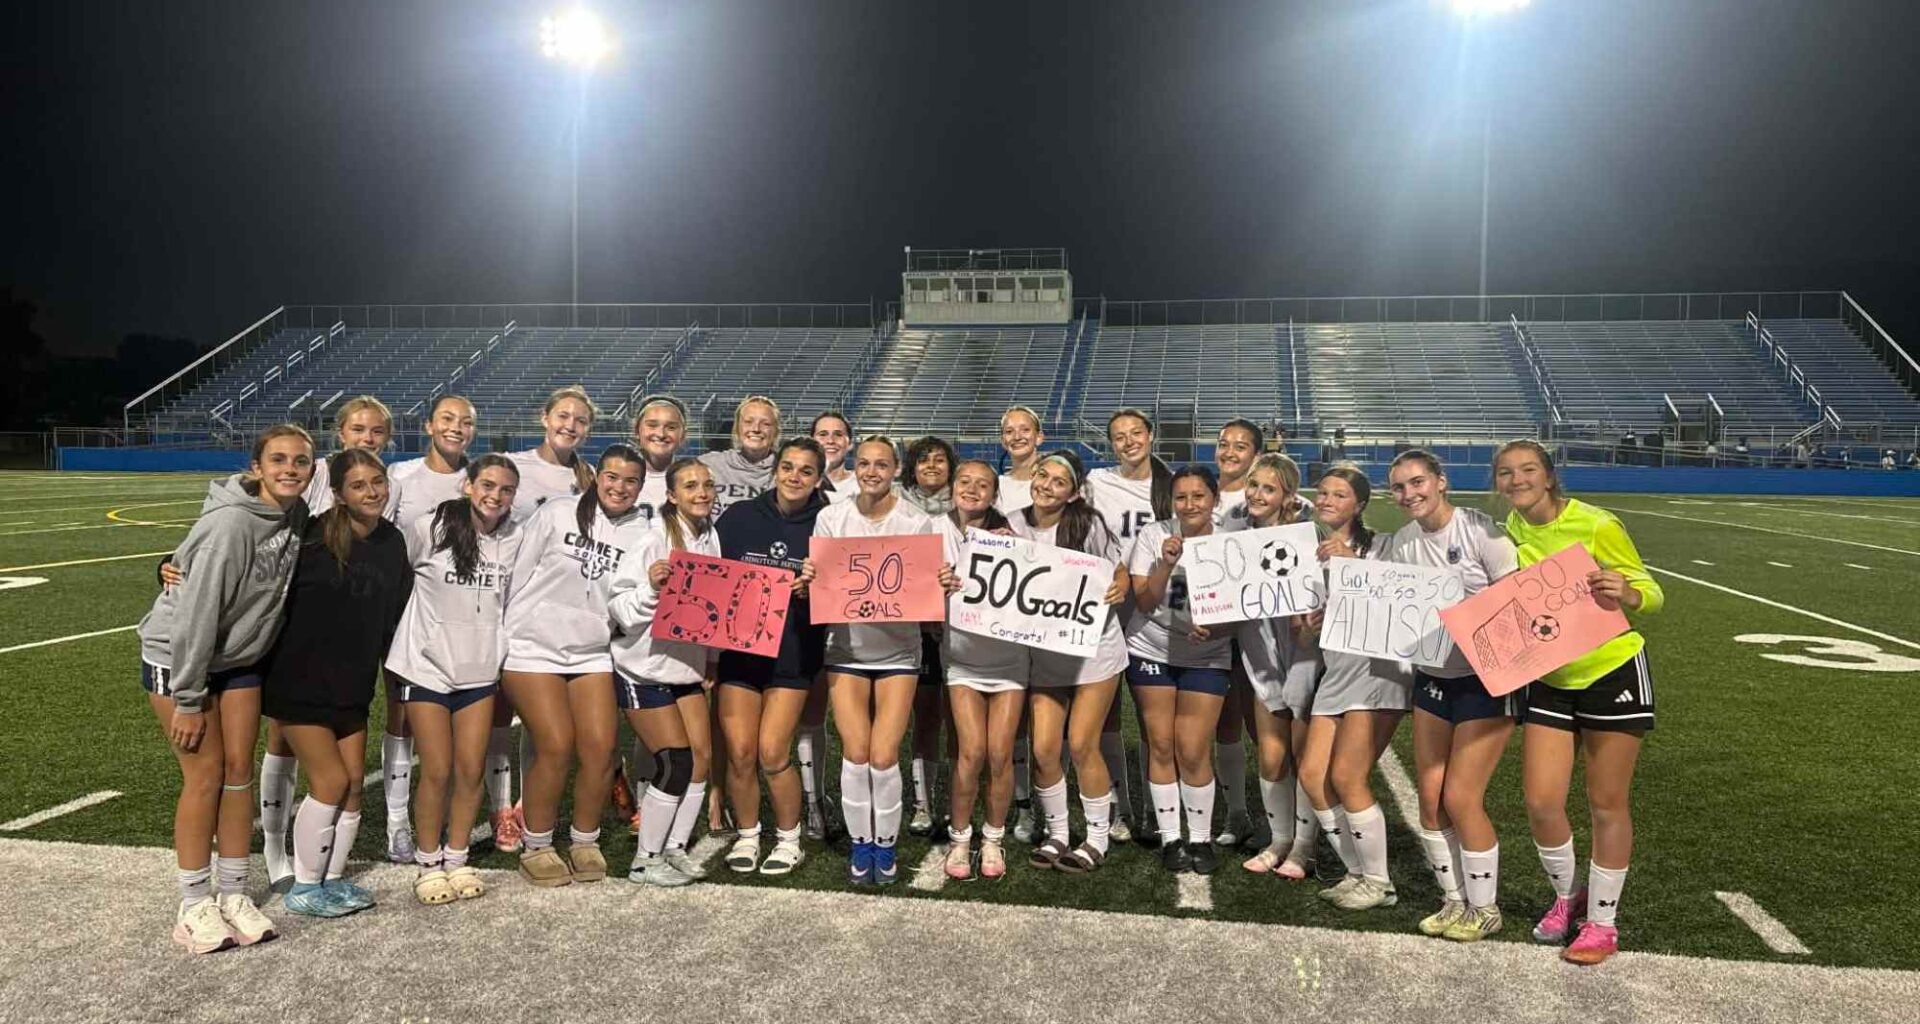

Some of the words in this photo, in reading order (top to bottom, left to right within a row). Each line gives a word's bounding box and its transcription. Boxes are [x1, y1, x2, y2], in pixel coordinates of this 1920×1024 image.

[564, 531, 626, 562] COMET
[1194, 537, 1246, 589] 50
[848, 552, 903, 595] 50
[1424, 575, 1460, 601] 50
[1513, 558, 1566, 601] 50
[668, 561, 772, 648] 50
[1240, 574, 1320, 620] GOALS
[990, 621, 1047, 644] Congrats!
[1058, 628, 1085, 646] #11
[1140, 661, 1161, 675] AH
